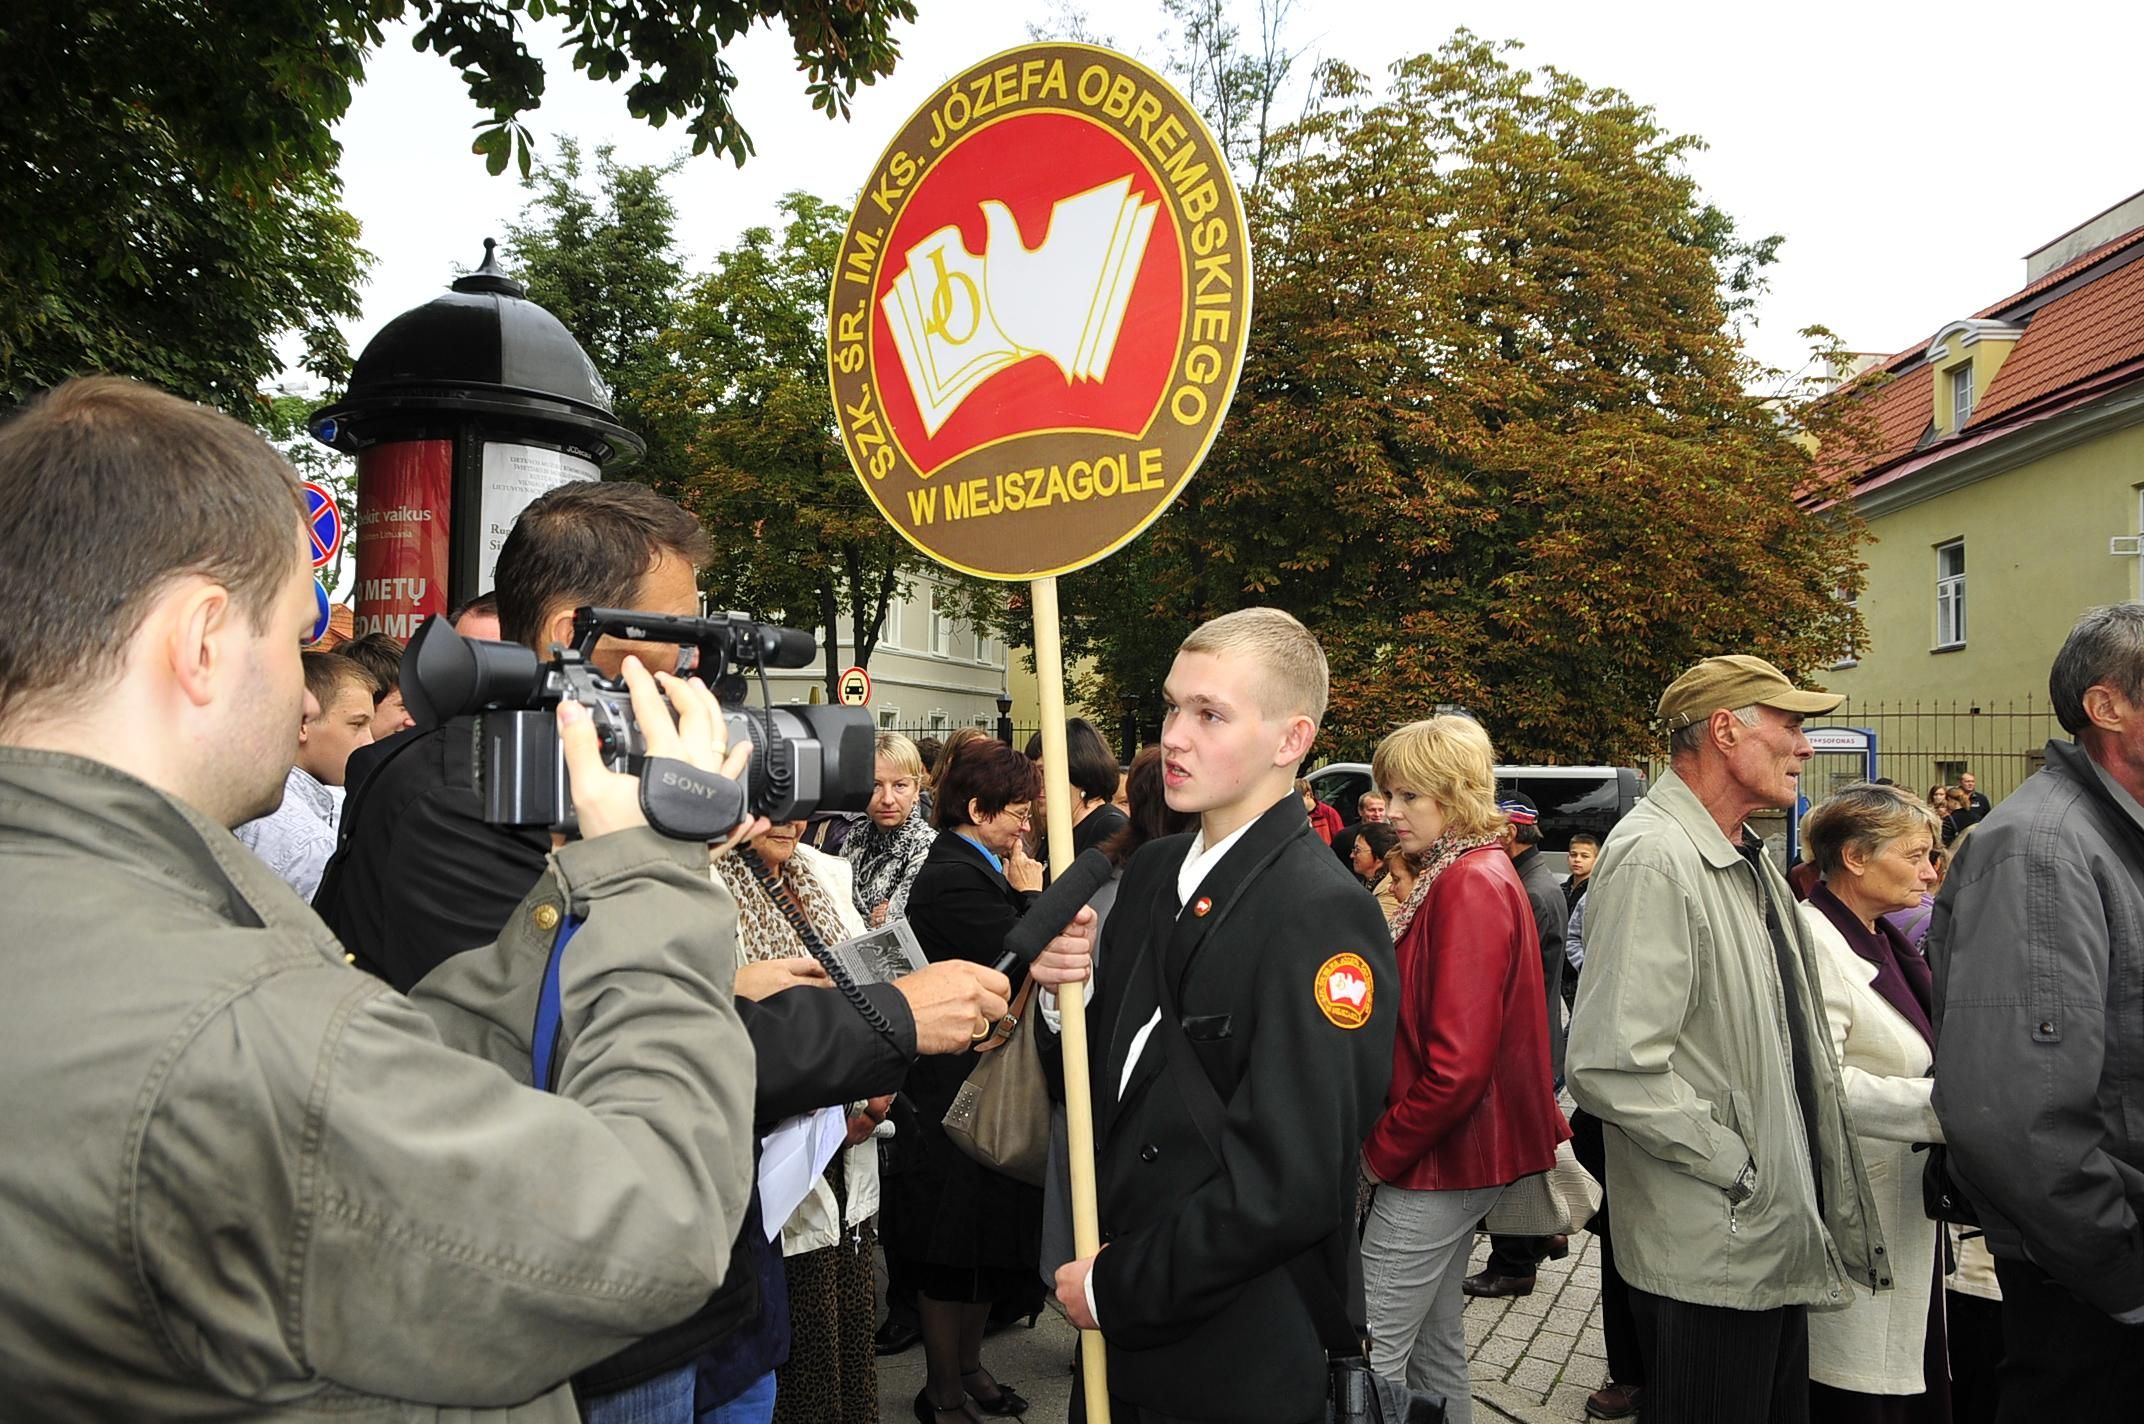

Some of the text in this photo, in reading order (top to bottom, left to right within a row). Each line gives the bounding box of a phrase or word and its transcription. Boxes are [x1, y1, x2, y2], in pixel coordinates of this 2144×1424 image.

[833, 58, 1232, 480] SZK. ŚR. IM. KS. JÓZEFA OBREMBSKIEGO
[907, 448, 1165, 526] W MEJSZAGOLE
[383, 506, 432, 522] vaikus
[365, 577, 427, 606] METŲ
[662, 771, 717, 799] SONY
